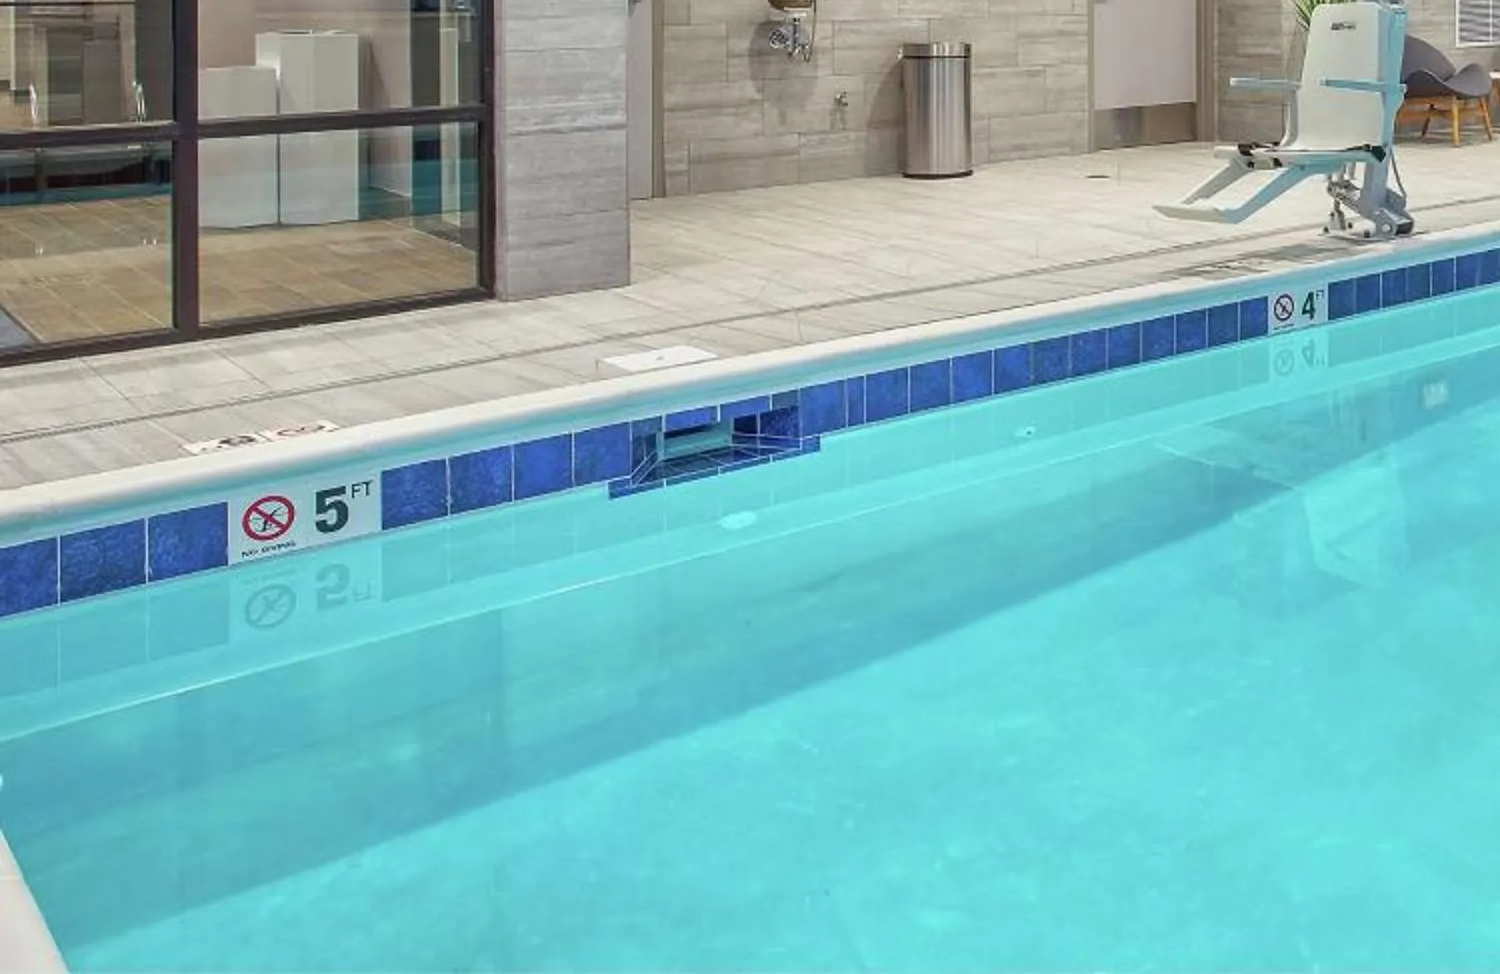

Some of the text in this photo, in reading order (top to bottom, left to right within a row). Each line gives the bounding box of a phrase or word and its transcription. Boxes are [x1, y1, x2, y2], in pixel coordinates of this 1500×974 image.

[1301, 291, 1316, 320] 4
[314, 480, 374, 534] 5 FT
